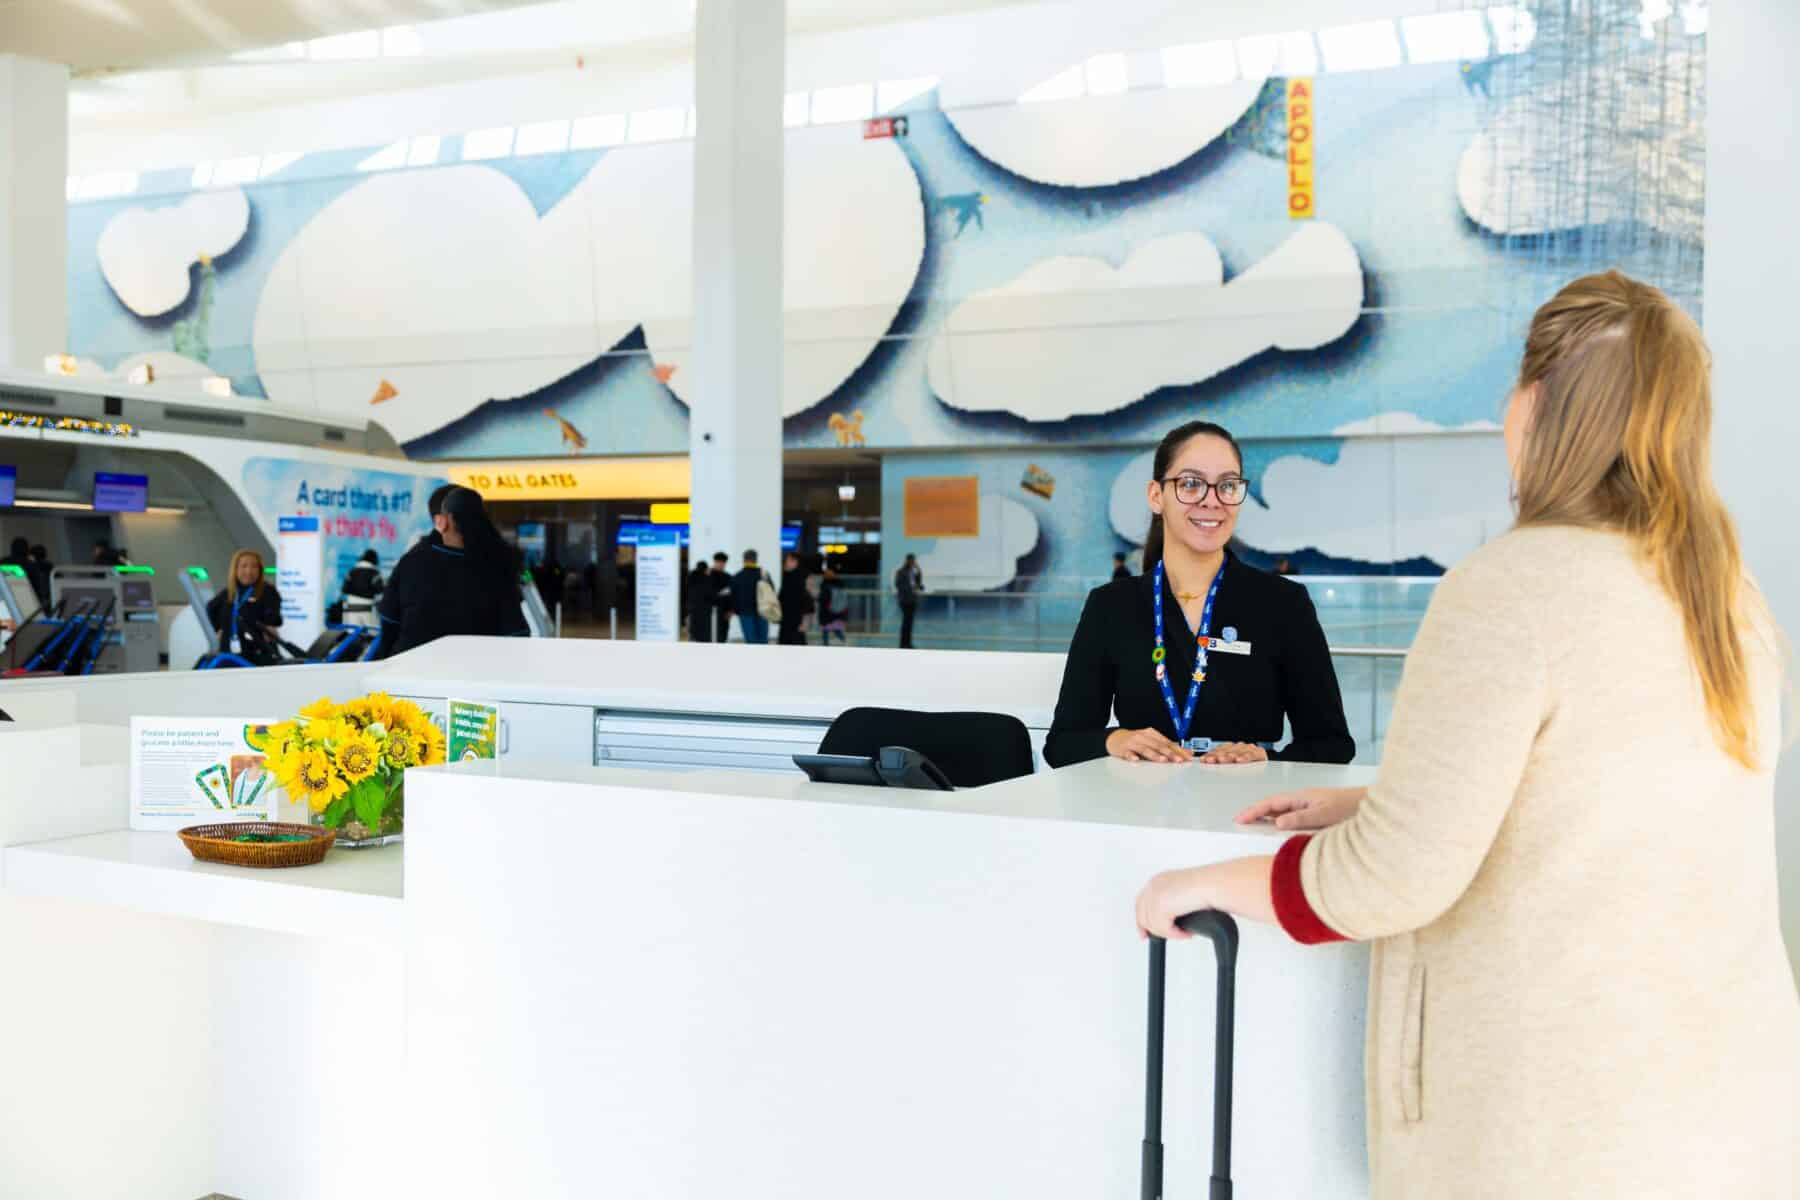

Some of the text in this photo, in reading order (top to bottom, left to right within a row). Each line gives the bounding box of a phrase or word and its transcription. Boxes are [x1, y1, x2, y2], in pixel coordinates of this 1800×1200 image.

[1289, 82, 1310, 211] APOLLO
[297, 480, 309, 504] A
[313, 486, 346, 508] card
[469, 472, 577, 489] TO ALL GATES
